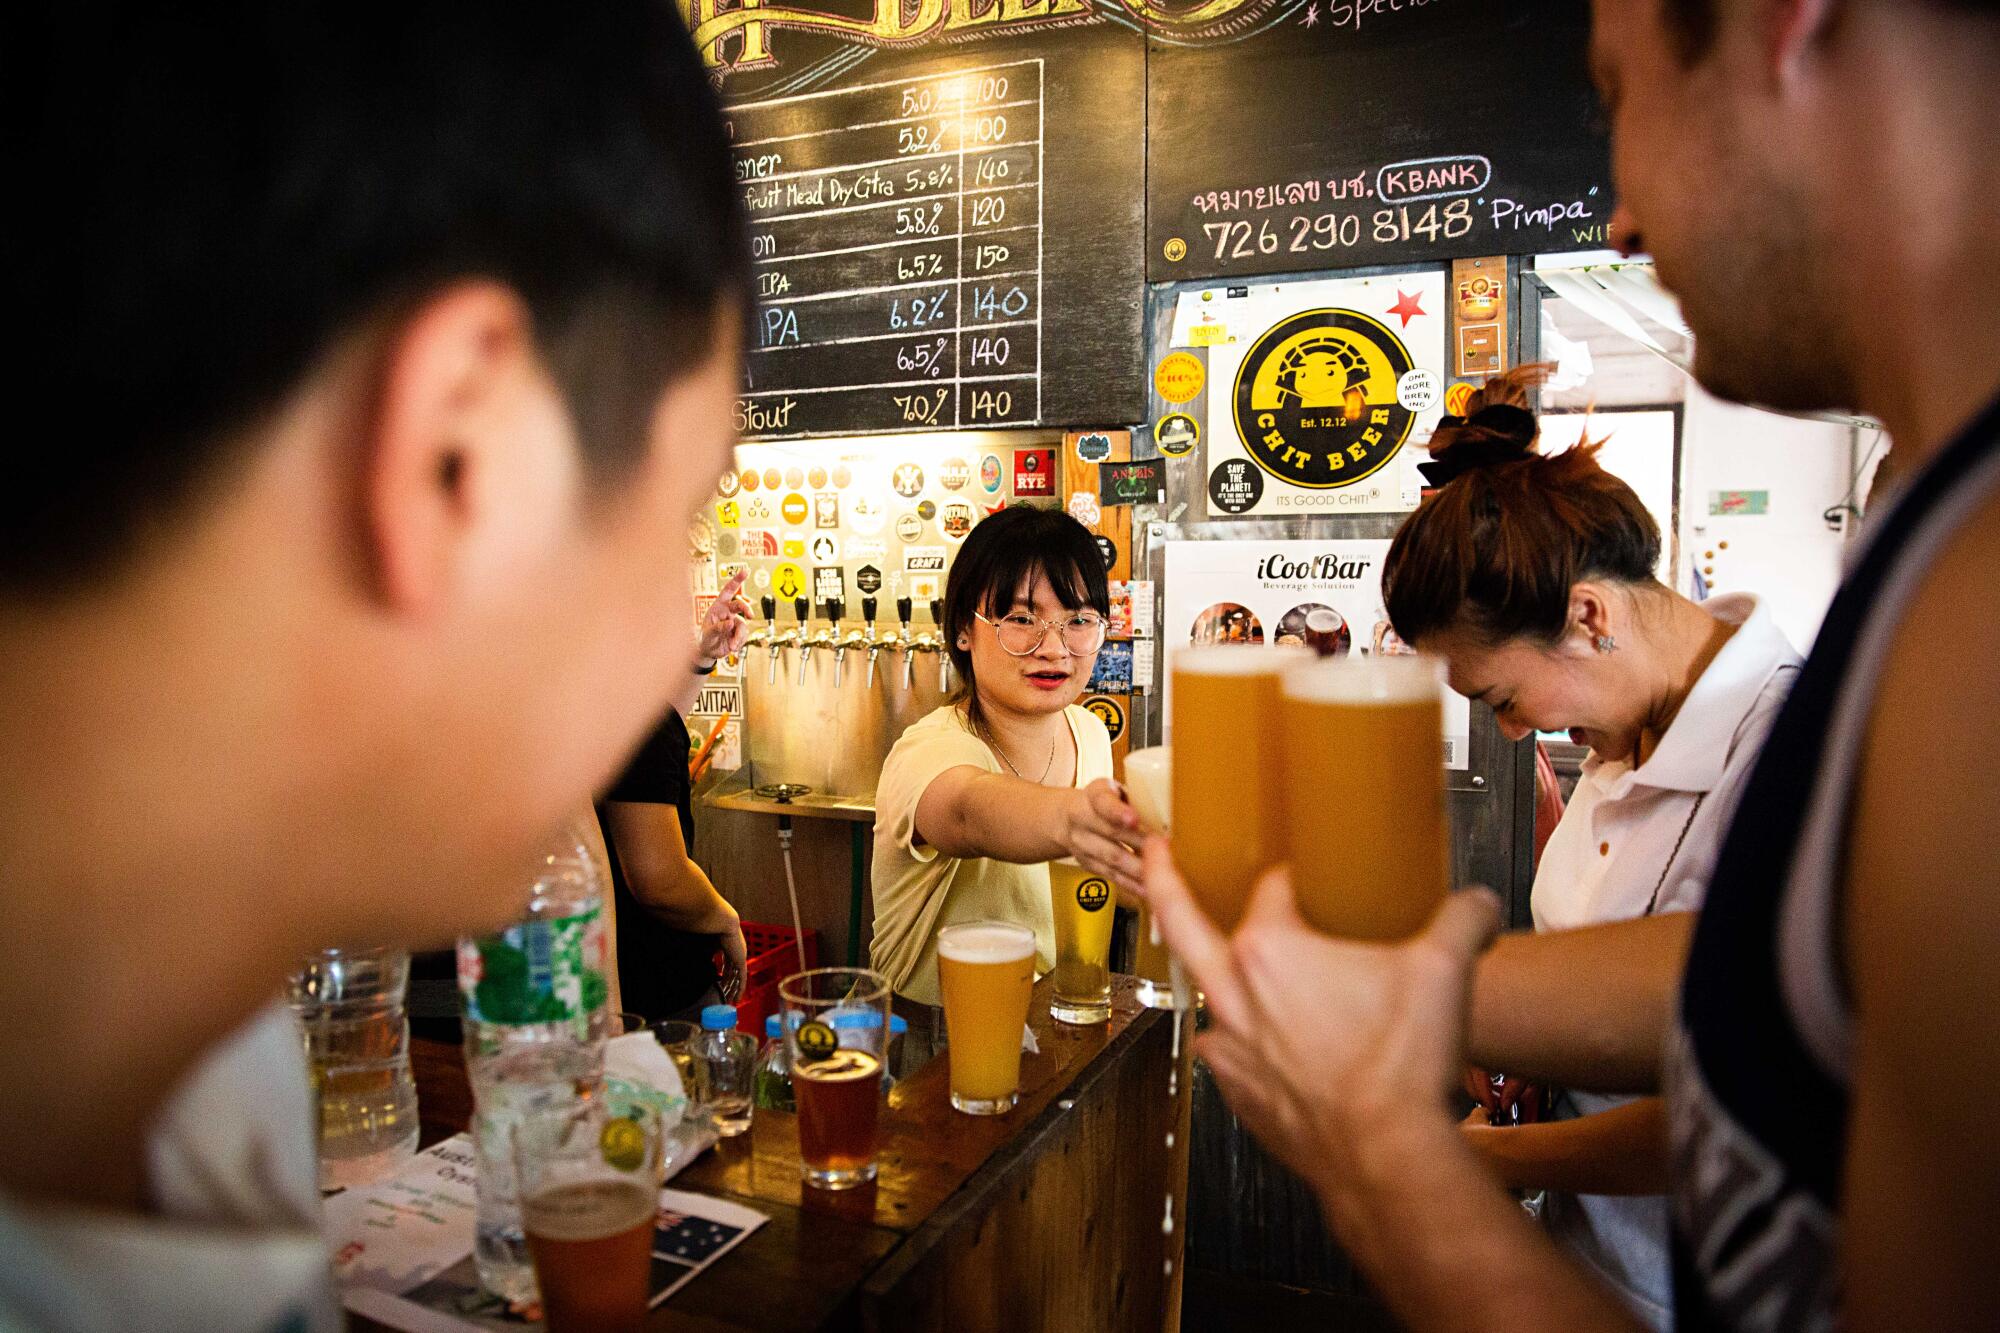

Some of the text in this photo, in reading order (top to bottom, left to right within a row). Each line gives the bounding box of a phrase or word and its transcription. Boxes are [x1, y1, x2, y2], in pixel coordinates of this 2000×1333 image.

[976, 77, 1009, 103] 100
[898, 116, 1007, 154] 5.2% 100
[733, 153, 781, 179] sner
[1386, 163, 1479, 194] KBANK
[786, 178, 824, 207] Mead
[904, 164, 954, 192] 5.8%
[975, 156, 1009, 186] 140
[1193, 179, 1321, 214] หมายเลข
[896, 202, 944, 236] 5.8%
[972, 196, 1005, 227] 120
[1203, 218, 1278, 260] 726
[1289, 213, 1361, 252] 290
[1372, 198, 1473, 244] 8148
[757, 245, 1009, 298] IPA 6.5% 150
[759, 285, 1028, 346] IPA 6.2% 140
[897, 337, 1010, 377] 6.5% 140
[1404, 392, 1431, 400] BREW
[1405, 381, 1431, 391] MORE
[732, 388, 1012, 431] Stout 7.0% 140
[1300, 417, 1347, 429] Est. 12.12
[1257, 408, 1390, 471] CHIT BEER
[1227, 464, 1246, 474] SAVE
[1230, 473, 1243, 483] THE
[1017, 477, 1046, 489] RYE
[1220, 482, 1251, 493] PLANET!
[1276, 496, 1290, 506] ITS
[1294, 495, 1335, 506] GOOD
[909, 557, 942, 569] CRAFT
[1257, 553, 1371, 580] iCoolBar
[1263, 581, 1356, 592] Beverage Solution
